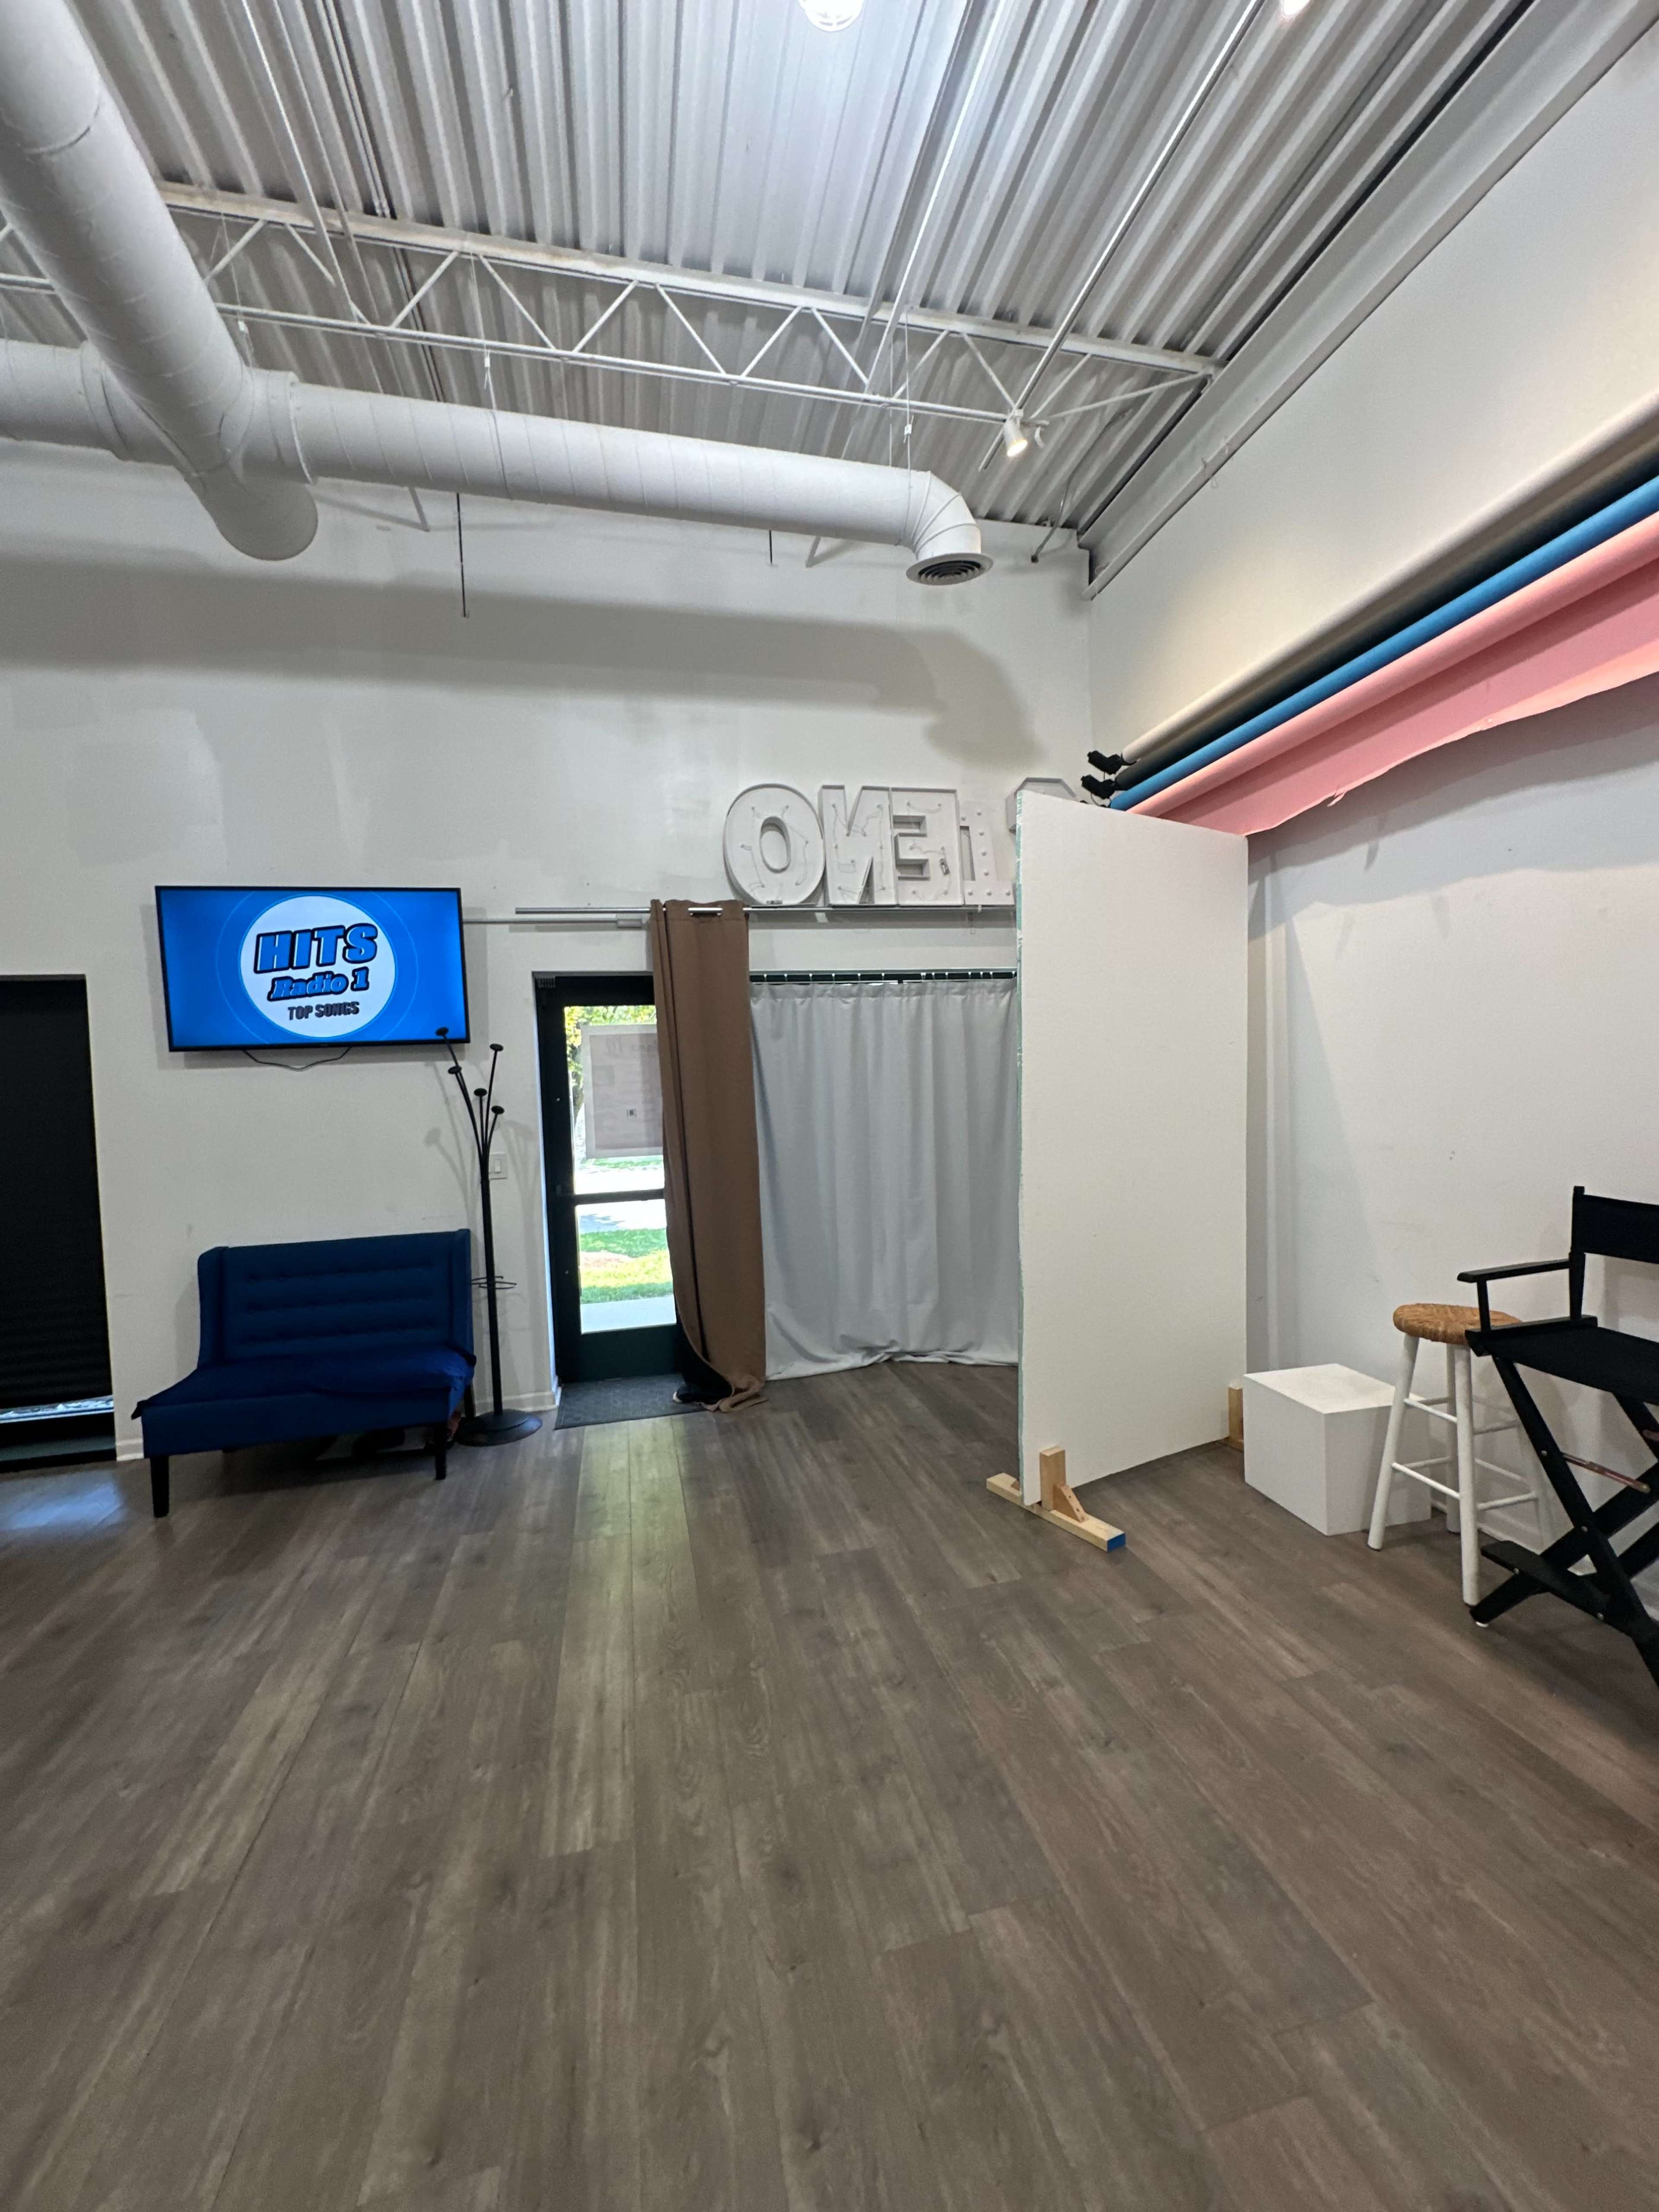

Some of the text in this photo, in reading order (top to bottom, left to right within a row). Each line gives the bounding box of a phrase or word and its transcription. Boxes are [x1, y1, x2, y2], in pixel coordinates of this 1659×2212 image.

[254, 923, 378, 974] HITS
[267, 966, 370, 1002] Radio 1
[288, 1001, 360, 1020] TOP SONGS
